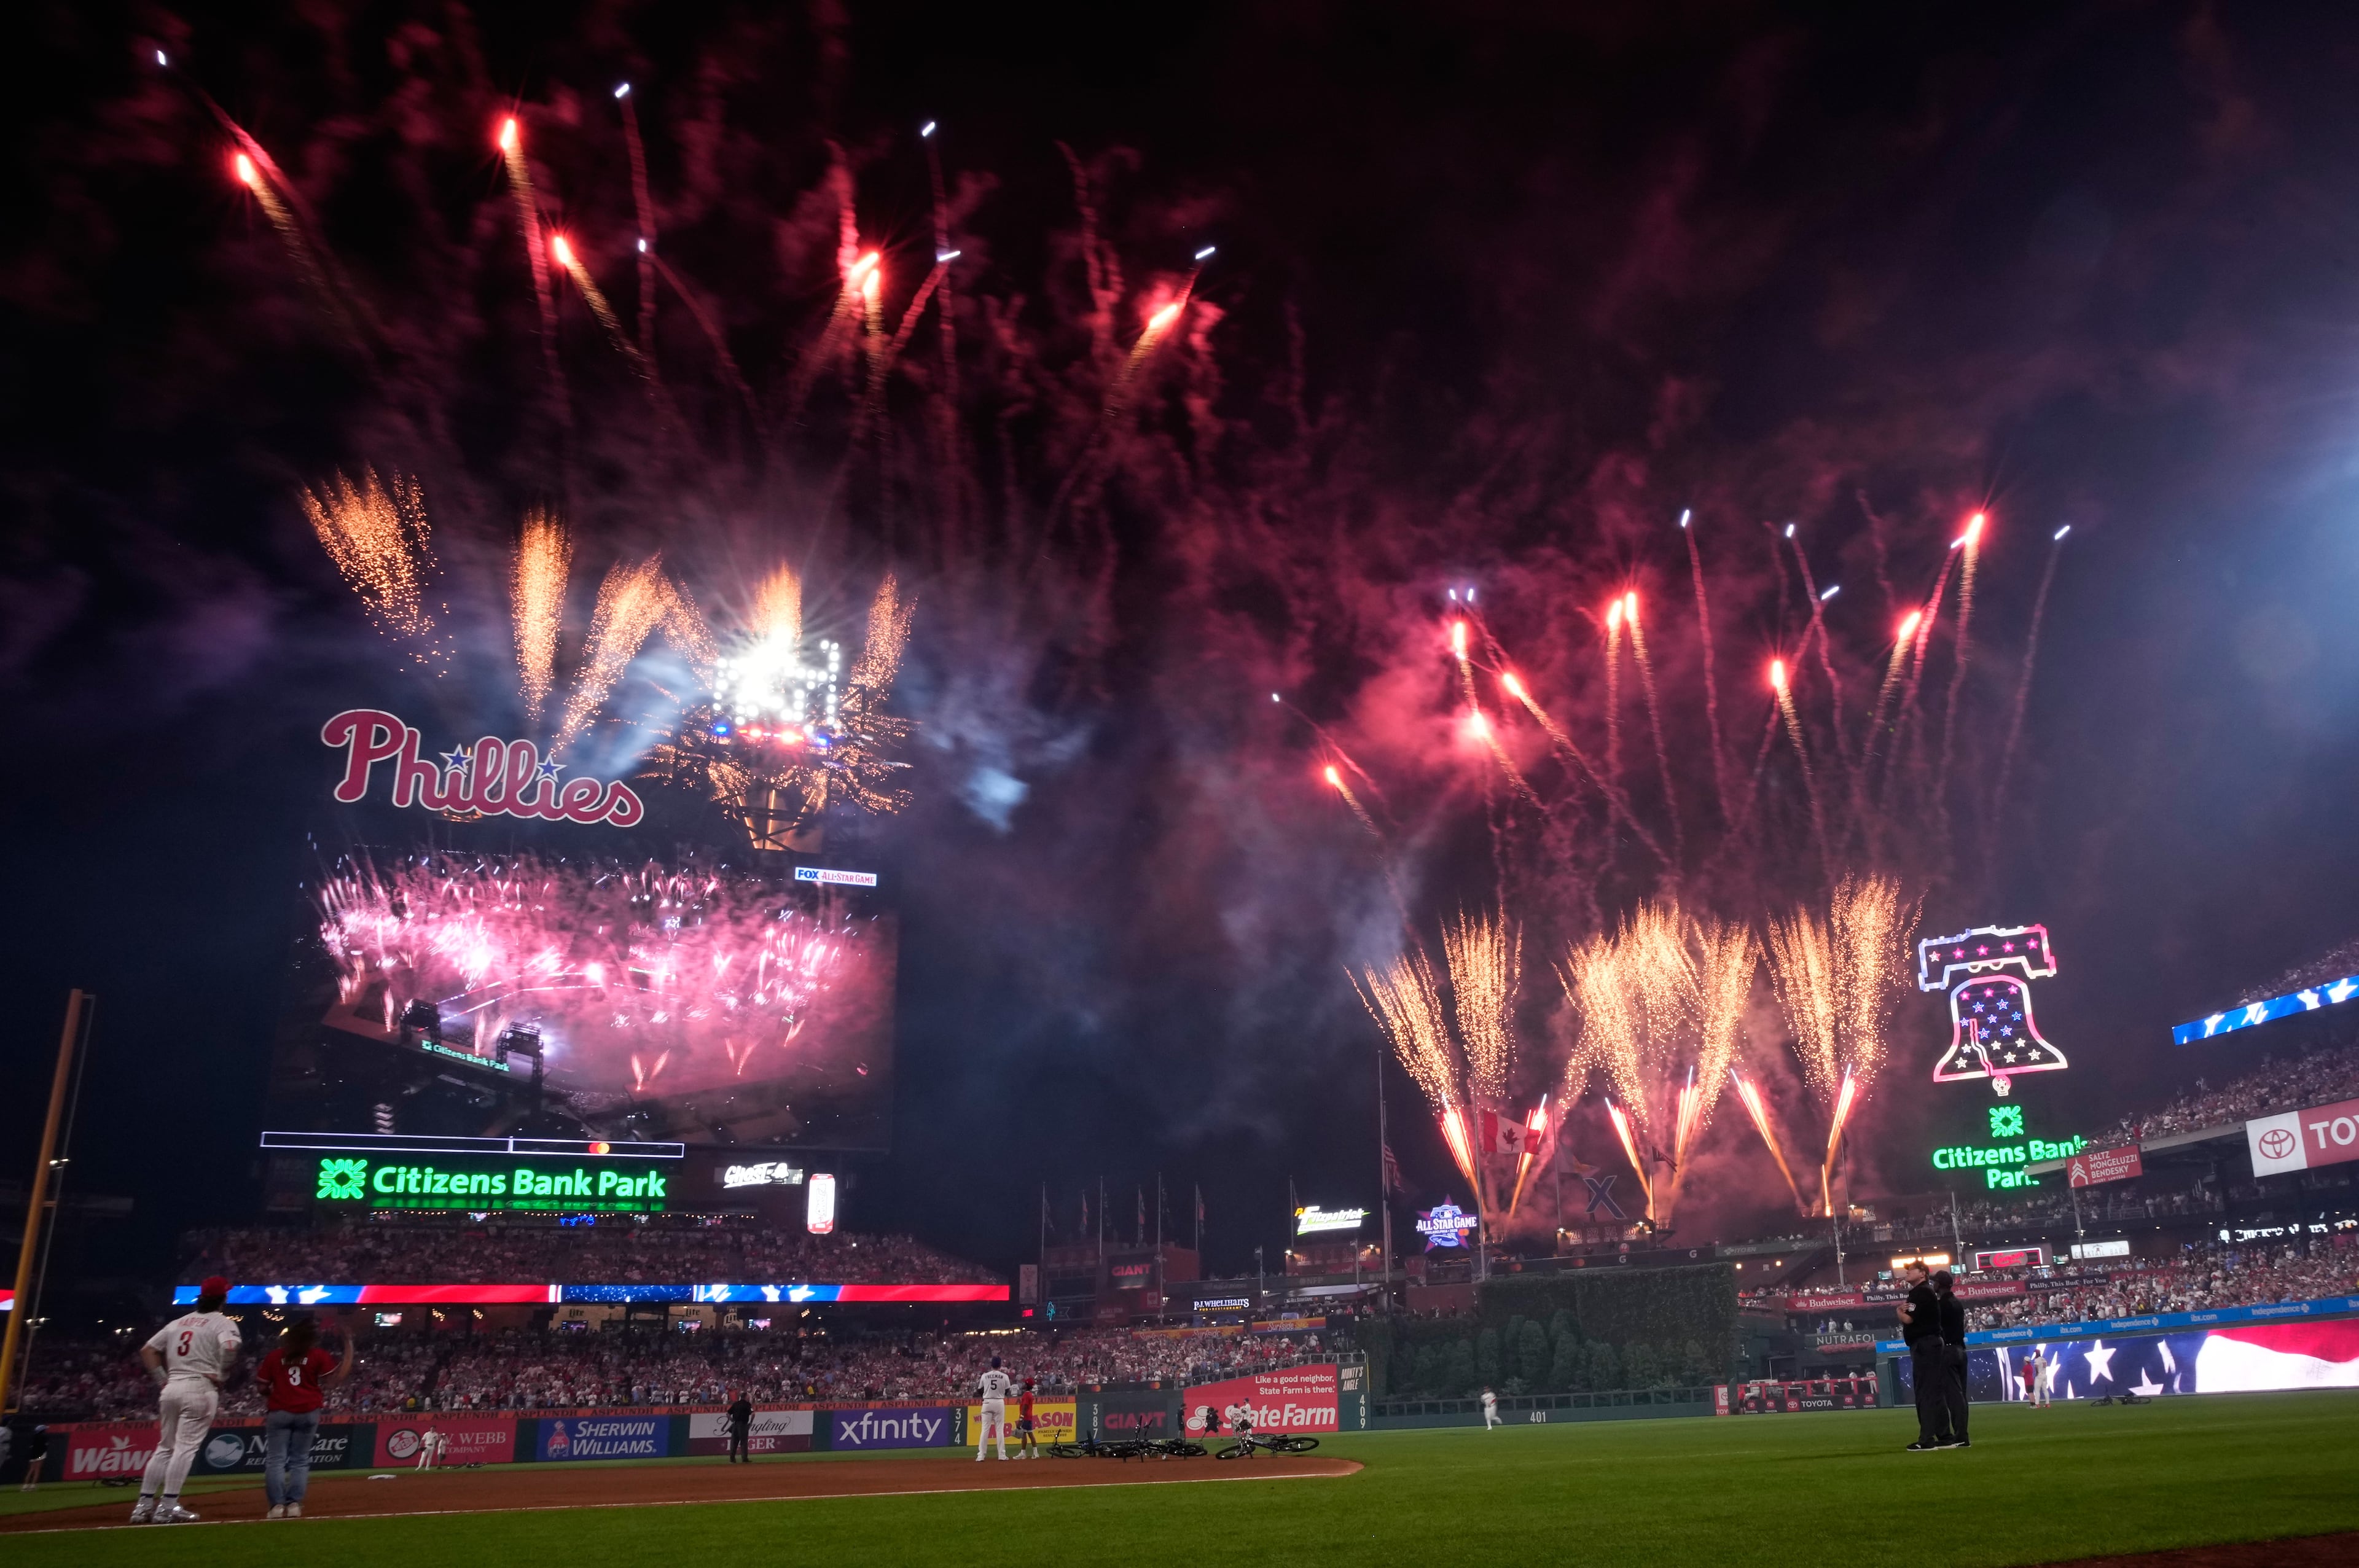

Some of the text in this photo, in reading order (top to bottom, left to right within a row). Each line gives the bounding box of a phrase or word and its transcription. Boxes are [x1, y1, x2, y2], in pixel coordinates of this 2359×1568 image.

[321, 709, 644, 827] Phillies
[798, 869, 819, 880] FOX
[856, 875, 874, 884] GAME
[433, 1045, 510, 1072] Citizens Bank Park
[1933, 1145, 2026, 1169] Citizens
[2089, 1151, 2110, 1161] SALTZ
[2090, 1154, 2138, 1170] MONGELUZZI
[724, 1163, 777, 1188] GHOST
[2091, 1165, 2129, 1179] BENDESKY
[372, 1166, 666, 1198] Citizens Bank Park
[1298, 1206, 1364, 1225] Fitzpatrick
[1416, 1217, 1477, 1231] ALL STAR GAME
[1112, 1263, 1152, 1276] GIANT
[569, 1309, 584, 1317] Lite
[2251, 1305, 2301, 1316] Independence
[2111, 1319, 2151, 1329] Independence
[2190, 1313, 2218, 1322] ibx.com
[1267, 1321, 1294, 1332] Surfside
[1817, 1333, 1877, 1345] NUTRAFOL
[1992, 1330, 2027, 1340] Independence
[178, 1331, 194, 1357] 3
[288, 1366, 302, 1386] 3
[1255, 1375, 1271, 1384] Like
[1280, 1375, 1298, 1385] good
[1300, 1374, 1334, 1384] neighbor,
[1341, 1366, 1364, 1380] MONTY'S
[990, 1379, 997, 1391] 5
[1259, 1386, 1280, 1395] State
[1312, 1385, 1335, 1394] there.
[1342, 1379, 1359, 1392] ANGLE
[811, 1402, 869, 1410] ASPLUNDH
[881, 1400, 937, 1409] ASPLUNDH
[1801, 1400, 1833, 1408] TOYOTA
[348, 1414, 418, 1422] ASPLUNDH
[431, 1411, 499, 1421] ASPLUNDH
[512, 1410, 578, 1419] ASPLUNDH
[590, 1407, 654, 1416] ASPLUNDH
[1530, 1411, 1546, 1423] 401
[75, 1421, 154, 1432] ASPLUNDH
[1104, 1411, 1166, 1429] GIANT
[574, 1420, 655, 1438] SHERWIN
[839, 1411, 942, 1445] xfinity
[460, 1431, 507, 1445] WEBB
[573, 1438, 655, 1456] WILLIAMS
[71, 1447, 154, 1474] Waw
